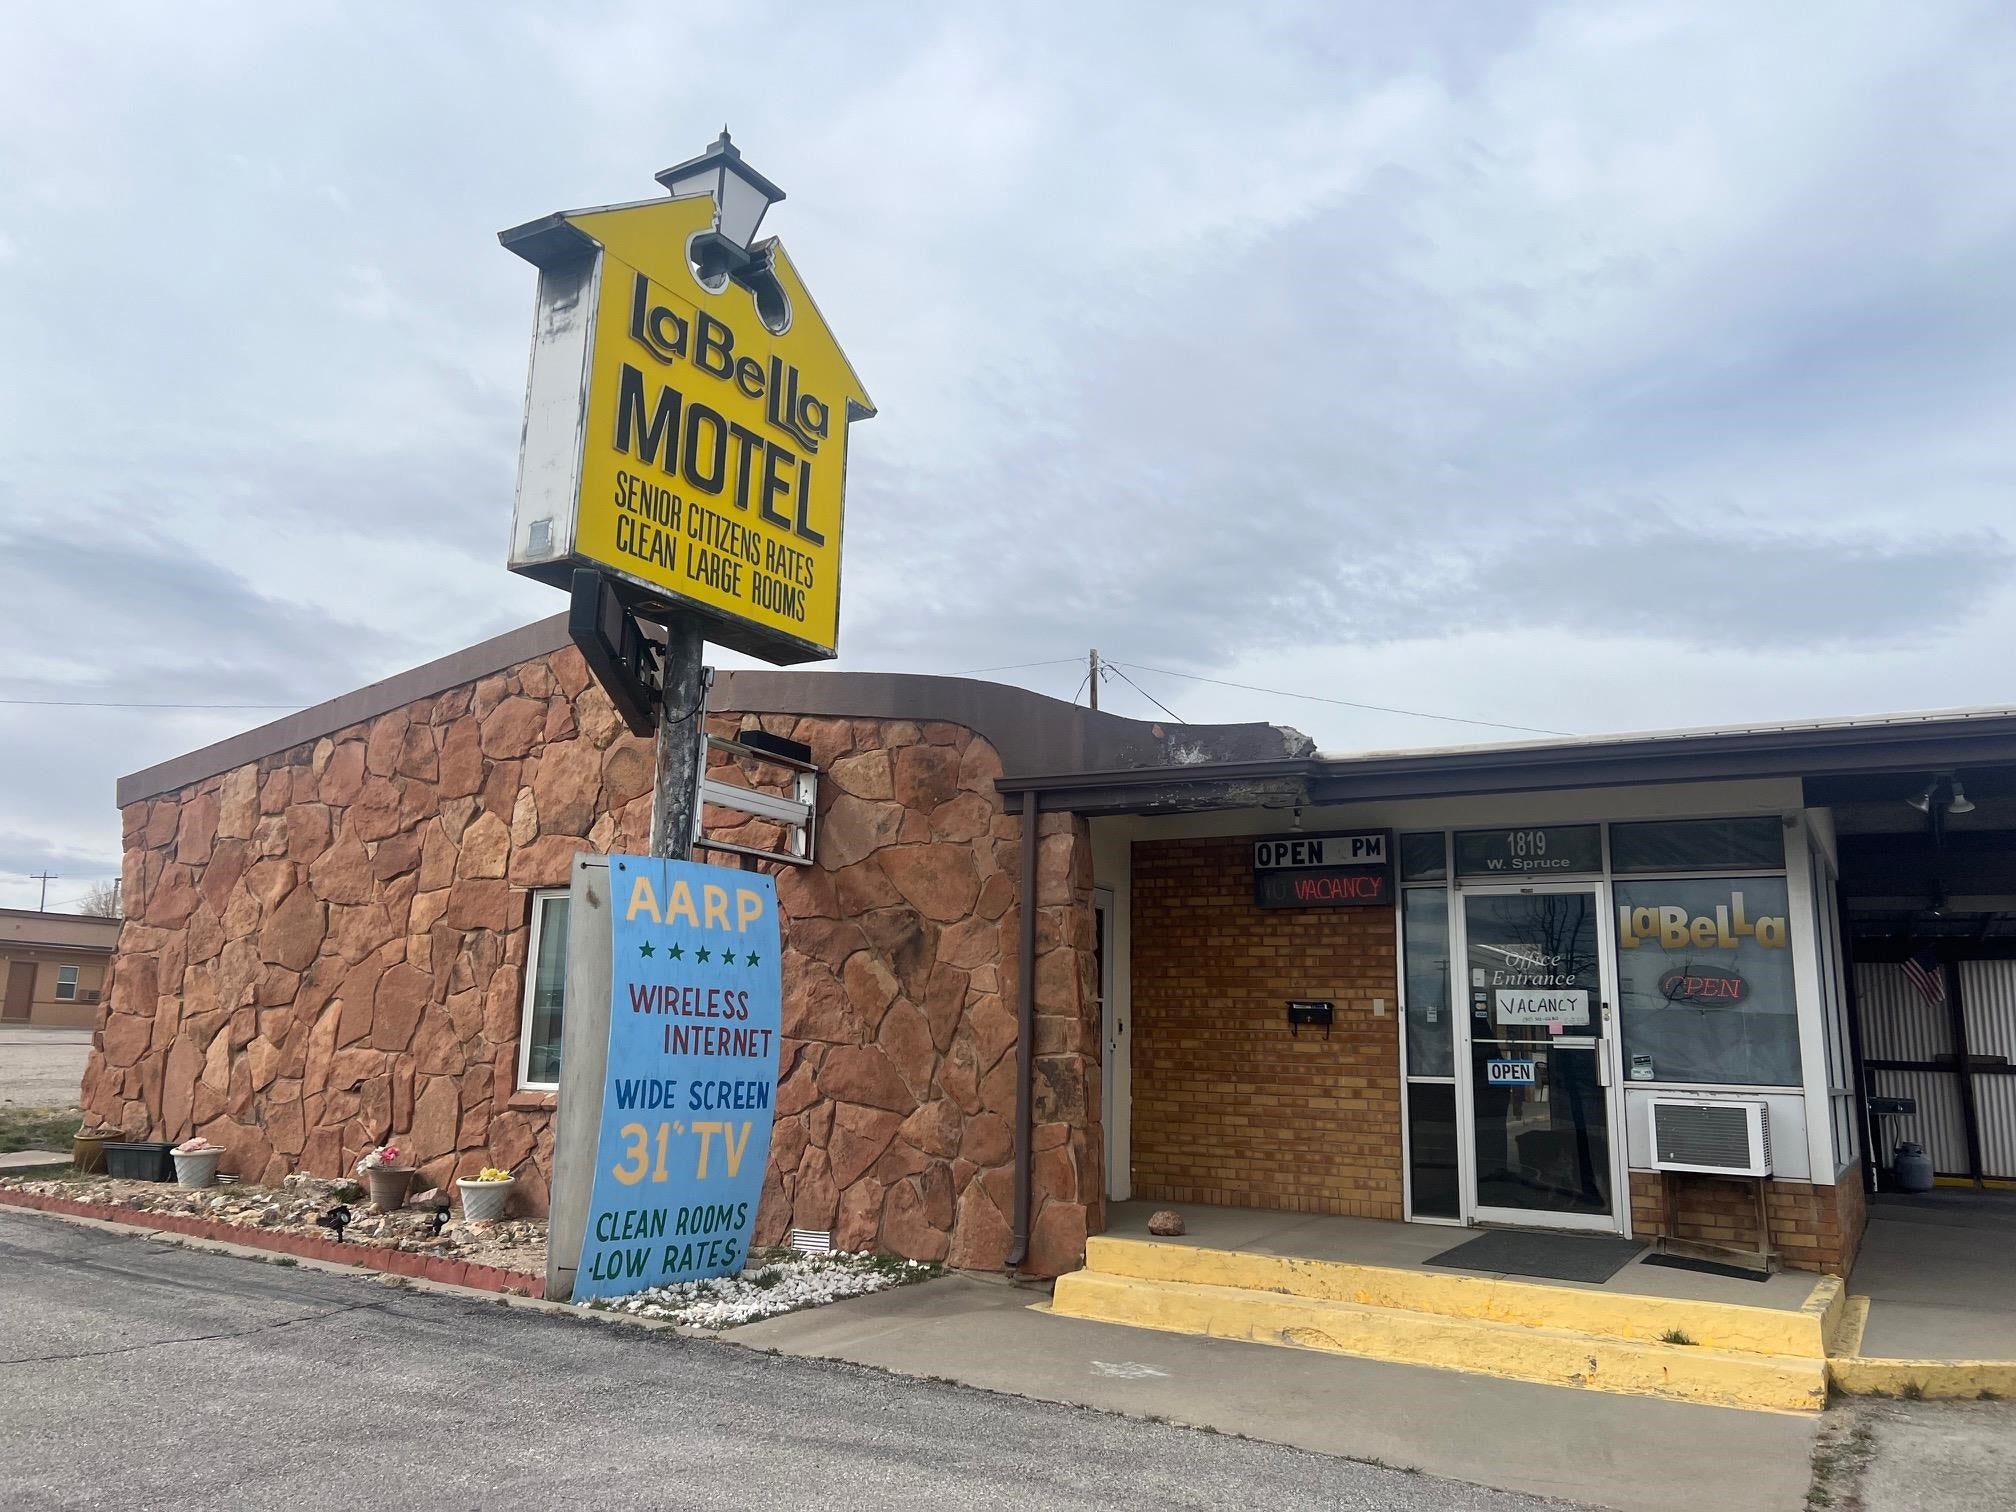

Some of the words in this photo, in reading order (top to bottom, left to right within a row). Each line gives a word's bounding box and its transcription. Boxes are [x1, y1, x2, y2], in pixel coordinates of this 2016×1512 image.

[614, 363, 825, 547] MOTEL
[614, 470, 682, 533] SENIOR
[687, 502, 762, 566] CITIZENS
[767, 544, 815, 590] RATES
[616, 517, 677, 572] CLEAN
[686, 548, 742, 598] LARGE
[752, 583, 806, 624] ROOMS
[1257, 840, 1324, 866] OPEN
[1351, 837, 1381, 858] PM
[1507, 831, 1546, 856] 1819
[1487, 859, 1507, 870] W.
[1511, 858, 1571, 871] Spruce
[1295, 877, 1383, 900] VACANCY
[626, 876, 764, 933] AARP
[1505, 952, 1561, 971] Office
[1492, 970, 1576, 986] Entrance
[1665, 975, 1741, 998] OPEN
[629, 983, 749, 1021] WIRELESS
[1500, 998, 1578, 1015] VACANCY
[664, 1023, 773, 1058] INTERNET
[1492, 1064, 1531, 1080] OPEN
[615, 1079, 677, 1110] WIDE
[689, 1081, 769, 1110] SCREEN
[691, 1121, 753, 1180] TV
[596, 1208, 668, 1243] CLEAN
[675, 1202, 748, 1236] ROOMS
